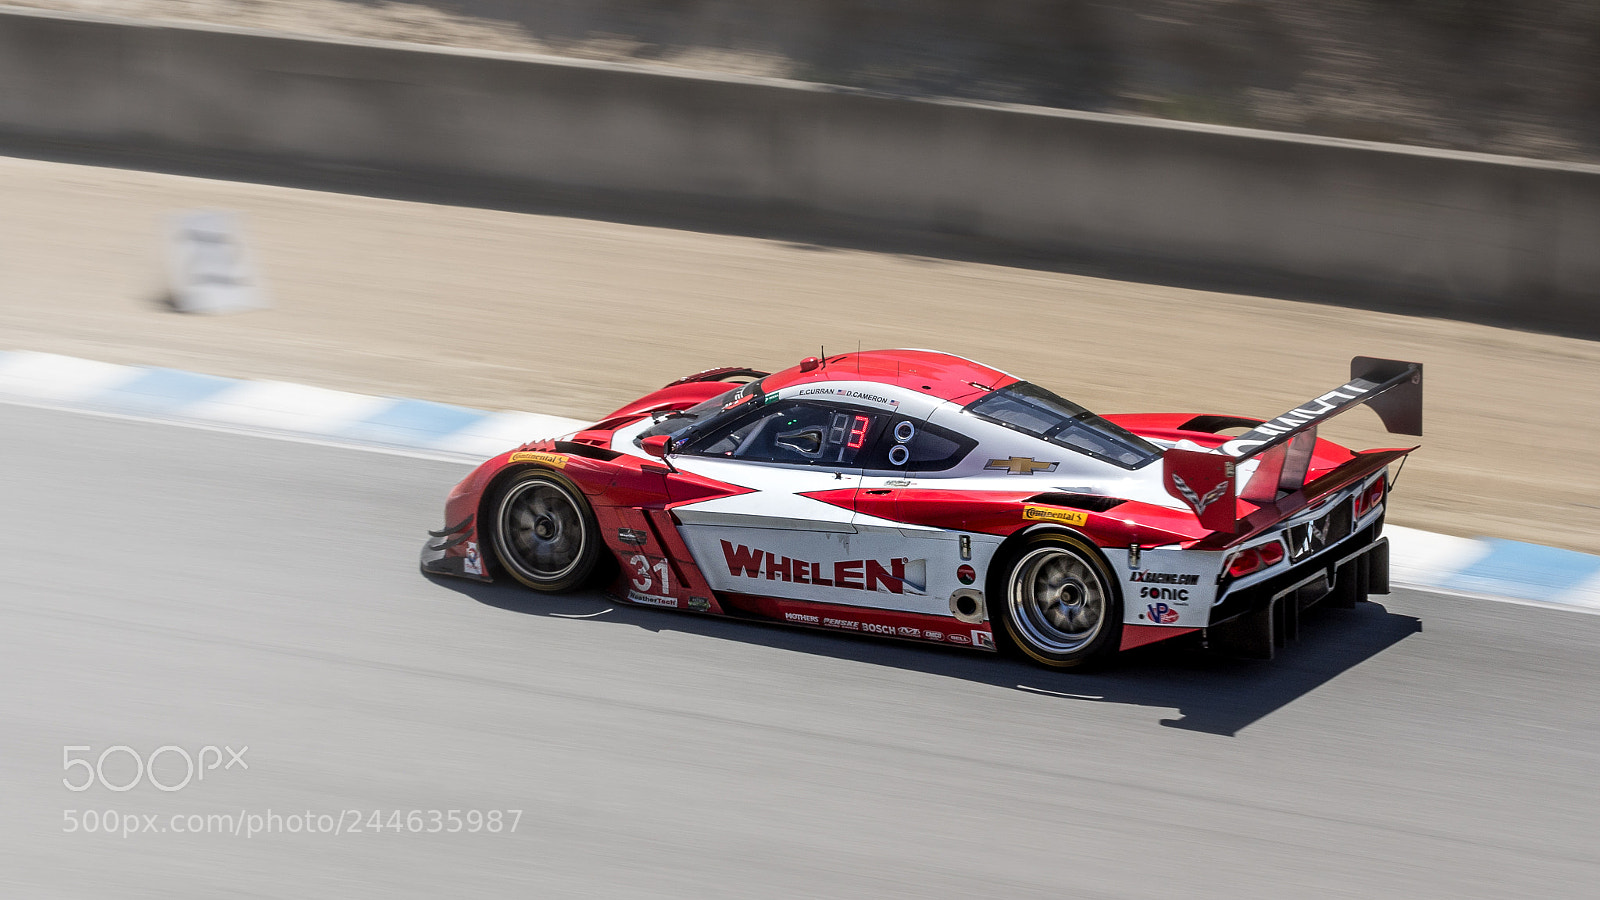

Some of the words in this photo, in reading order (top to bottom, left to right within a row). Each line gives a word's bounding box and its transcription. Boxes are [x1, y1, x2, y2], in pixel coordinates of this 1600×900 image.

[799, 388, 835, 396] E.CURRAN
[846, 390, 888, 404] D.CAMERON
[512, 452, 557, 463] Continental
[1026, 507, 1074, 521] Continental
[630, 554, 670, 595] 31
[719, 538, 906, 595] WHELEN
[784, 612, 820, 623] MOTHERS
[823, 617, 860, 628] PENSKE
[862, 622, 897, 635] BOSCH
